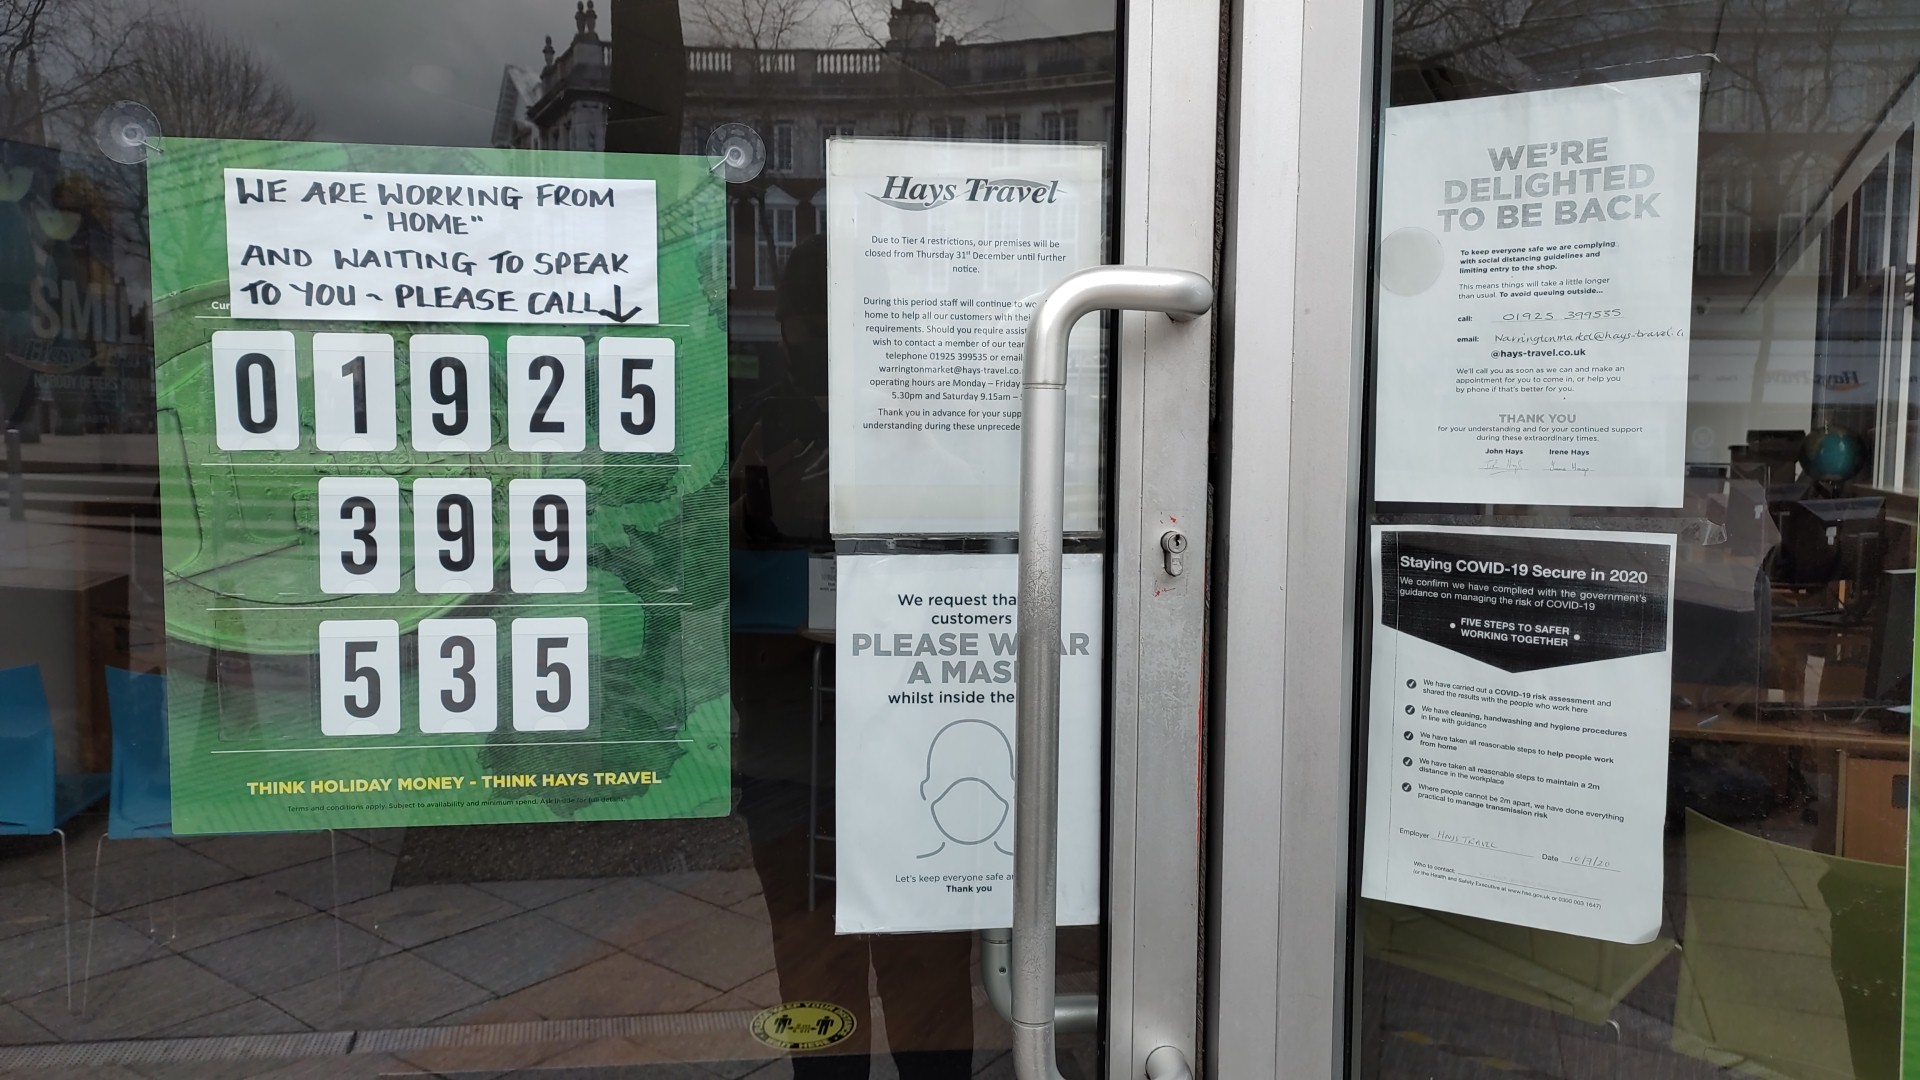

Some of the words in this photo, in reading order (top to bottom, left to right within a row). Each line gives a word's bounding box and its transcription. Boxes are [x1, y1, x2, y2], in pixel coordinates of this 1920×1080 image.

[1487, 136, 1608, 172] WE'RE
[881, 176, 957, 206] Hays
[964, 178, 1059, 204] Travel
[1444, 164, 1656, 204] DELIGHTED
[236, 178, 286, 204] WE
[302, 182, 367, 204] ARE
[378, 184, 523, 208] WORKING
[537, 184, 614, 208] FROM
[1438, 207, 1486, 232] TO
[1496, 203, 1542, 230] BE
[1554, 193, 1660, 226] BACK
[871, 235, 889, 244] Due
[890, 236, 900, 244] to
[901, 236, 918, 245] Tier
[919, 236, 925, 245] 4
[927, 236, 976, 247] restrictions,
[977, 239, 993, 247] our
[994, 238, 1031, 250] premises
[1032, 239, 1048, 248] will
[1049, 239, 1060, 248] be
[1491, 247, 1526, 255] everyone
[1573, 240, 1616, 250] complying
[240, 245, 312, 266] AND
[334, 249, 477, 275] WAITING
[489, 250, 524, 274] TO
[534, 252, 628, 275] SPEAK
[864, 248, 892, 258] closed
[893, 249, 914, 258] from
[915, 249, 954, 261] Thursday
[972, 251, 1015, 261] December
[1016, 252, 1035, 261] until
[1037, 252, 1067, 262] further
[1477, 256, 1500, 264] social
[1501, 254, 1542, 263] distancing
[1543, 252, 1583, 262] guidelines
[1585, 250, 1600, 258] and
[952, 264, 980, 273] notice.
[1459, 266, 1488, 274] limiting
[1536, 263, 1557, 271] shop.
[240, 280, 282, 306] TO
[290, 281, 355, 306] YOU
[396, 285, 518, 312] PLEASE
[528, 291, 601, 315] CALL
[863, 296, 891, 307] During
[893, 297, 909, 306] this
[910, 297, 938, 308] period
[939, 298, 958, 307] staff
[959, 298, 974, 307] will
[975, 299, 1012, 308] continue
[1013, 298, 1023, 308] to
[31, 278, 153, 344] SMIL
[1502, 312, 1554, 322] 01925
[885, 351, 928, 362] telephone
[929, 351, 956, 361] 01925
[957, 352, 988, 361] 399535
[1000, 353, 1024, 362] email
[1490, 348, 1586, 358] @hays-travel.co.uk
[878, 364, 1022, 376] warringtonmarket@hays-travel.co.
[1498, 413, 1545, 425] THANK
[1548, 413, 1576, 424] YOU
[1505, 448, 1523, 456] Hays
[1400, 555, 1452, 573] Staying
[1455, 559, 1529, 576] COVID-19
[1531, 564, 1586, 580] Secure
[1590, 567, 1605, 581] in
[1609, 569, 1648, 584] 2020
[1400, 576, 1414, 588] We
[1416, 578, 1449, 588] confirm
[1451, 582, 1465, 590] we
[1468, 581, 1489, 592] have
[1492, 585, 1534, 596] complied
[1537, 587, 1557, 597] with
[1560, 588, 1577, 598] the
[1579, 591, 1647, 603] government's
[898, 594, 922, 606] We
[928, 594, 987, 607] request
[992, 593, 1018, 606] tha
[1399, 587, 1439, 600] guidance
[1454, 593, 1497, 605] managing
[1498, 595, 1514, 606] the
[1514, 597, 1532, 607] risk
[1533, 598, 1545, 608] of
[1545, 599, 1596, 612] COVID-19
[931, 612, 1012, 625] customers
[1460, 617, 1482, 627] FIVE
[1483, 619, 1515, 631] STEPS
[1517, 622, 1532, 632] TO
[1534, 624, 1570, 635] SAFER
[852, 632, 979, 656] PLEASE
[988, 632, 1090, 656] WR
[1460, 628, 1508, 642] WORKING
[1510, 633, 1568, 647] TOGETHER
[908, 660, 931, 684] A
[887, 691, 934, 704] whilst
[939, 690, 985, 704] inside
[990, 690, 1016, 704] the
[246, 780, 306, 795] THINK
[310, 778, 393, 794] HOLIDAY
[397, 776, 465, 791] MONEY
[480, 774, 538, 788] THINK
[542, 772, 589, 787] HAYS
[592, 770, 665, 786] TRAVEL
[1399, 828, 1430, 839] Employer
[1542, 854, 1559, 862] Date
[895, 874, 917, 883] Let's
[918, 874, 941, 883] keep
[942, 874, 984, 883] everyone
[985, 872, 1004, 881] safe
[945, 884, 974, 893] Thank
[975, 885, 992, 894] you
